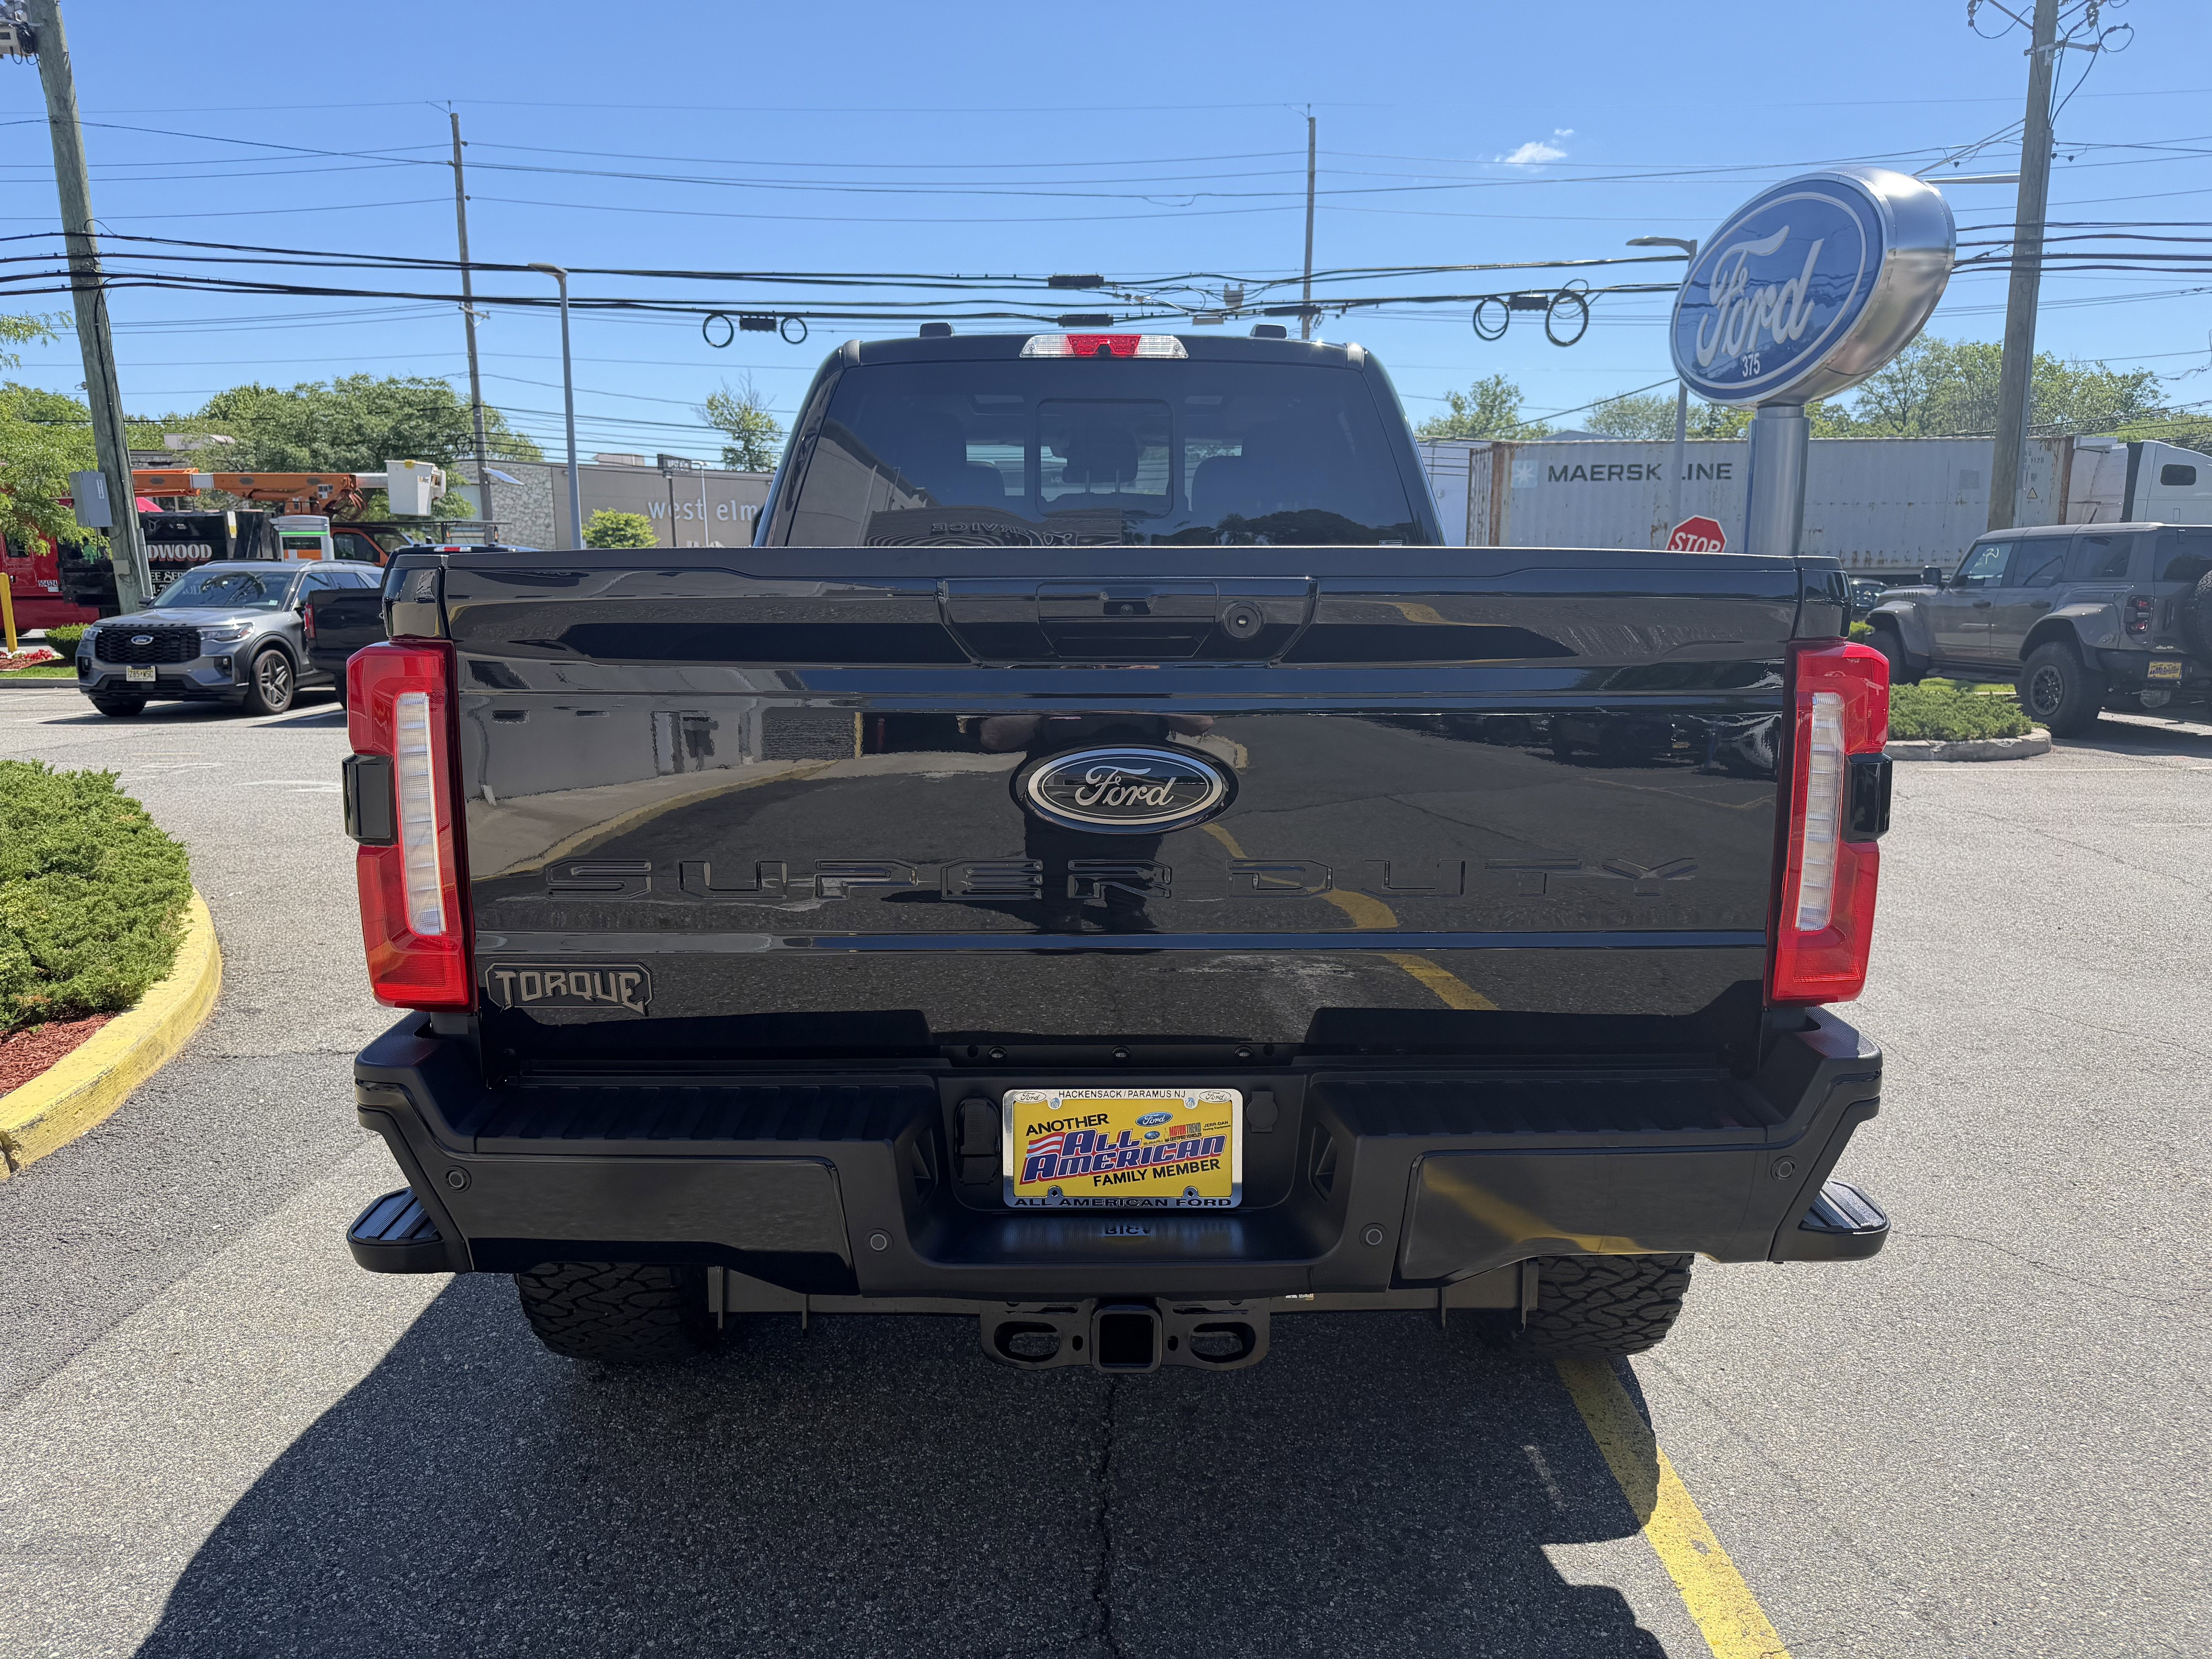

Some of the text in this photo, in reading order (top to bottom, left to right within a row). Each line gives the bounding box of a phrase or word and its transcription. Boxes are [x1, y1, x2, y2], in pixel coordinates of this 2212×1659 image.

[1696, 225, 1824, 367] Ford
[1742, 352, 1760, 378] 375
[1547, 463, 1733, 482] MAERSK INE
[647, 498, 758, 522] west elm
[147, 544, 213, 561] DWOOD
[1671, 532, 1721, 553] STOP
[1075, 765, 1177, 806] Ford
[546, 857, 1699, 900] SUPER DUTY
[494, 970, 647, 1017] TORQUE
[1020, 1092, 1040, 1101] Ford
[1205, 1092, 1224, 1101] Ford
[1025, 1113, 1110, 1137] ANOTHER
[1142, 1114, 1166, 1125] Ford
[1169, 1122, 1201, 1137] MOTOR TREND
[1093, 1158, 1221, 1187] FAMILY MEMBER
[1176, 1199, 1231, 1207] FORD
